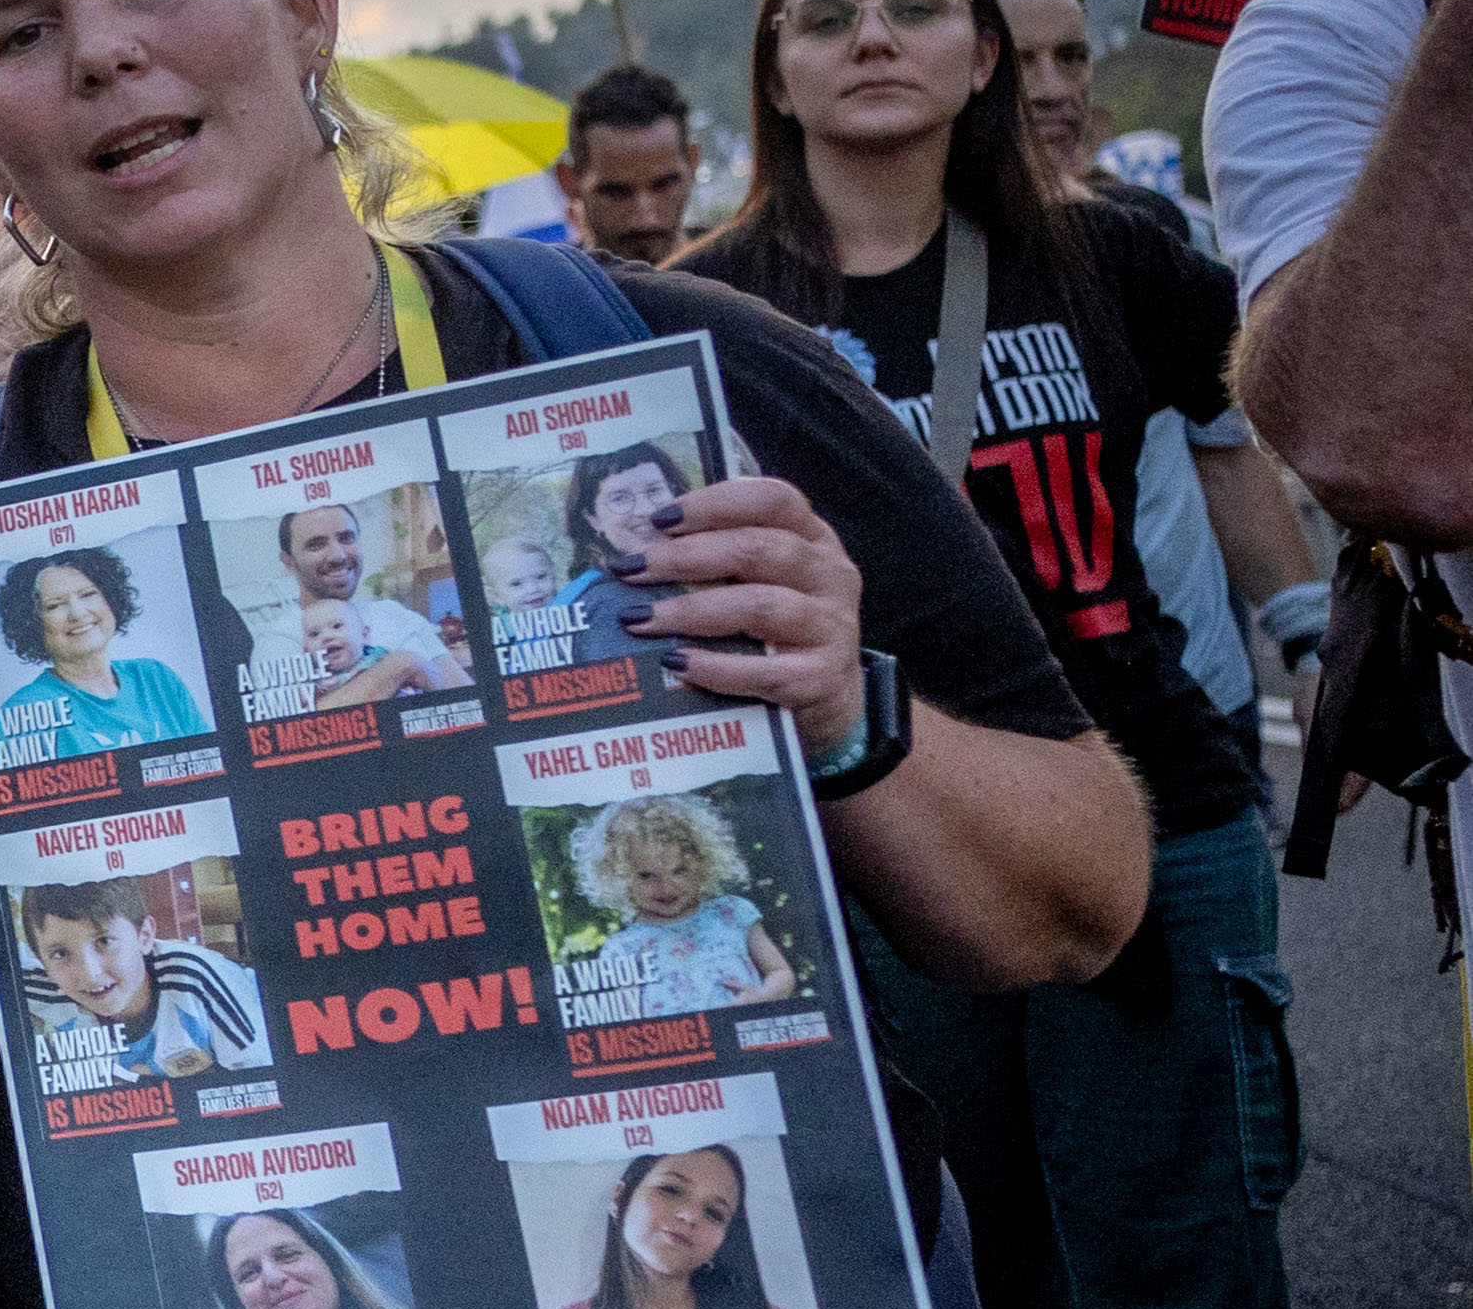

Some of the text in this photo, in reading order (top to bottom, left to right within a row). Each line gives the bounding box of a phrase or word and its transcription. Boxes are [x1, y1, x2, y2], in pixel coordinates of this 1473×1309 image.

[505, 390, 632, 439] ADI SHOHAM
[250, 440, 376, 490] TAL SHOHAM
[71, 480, 142, 518] HARAN
[304, 480, 332, 503] (38)
[48, 523, 76, 547] (67)
[510, 601, 591, 642] WHOLE
[257, 649, 333, 690] WHOLE
[494, 635, 575, 677] FAMILY
[241, 682, 318, 723] FAMILY
[503, 656, 639, 710] IS MISSING!
[247, 702, 379, 757] IS MISSING!
[523, 719, 747, 780] YAHEL GANI SHOHAM
[15, 751, 119, 801] MISSING!
[630, 766, 653, 790] (3)
[34, 808, 187, 858] NAVEH SHOHAM
[279, 794, 470, 860] BRING
[292, 845, 475, 907] THEM
[294, 895, 486, 959] HOME
[572, 951, 659, 991] WHOLE
[286, 966, 540, 1055] NOW!
[558, 988, 644, 1030] FAMILY
[53, 1022, 129, 1060] WHOLE
[566, 1032, 594, 1065] IS
[595, 1012, 713, 1061] MISSING!
[38, 1057, 114, 1095] FAMILY
[45, 1080, 177, 1129] IS MISSING!
[540, 1079, 725, 1131] NOAM AVIGDORI
[623, 1124, 655, 1150] (12)
[173, 1138, 357, 1187] SHARON AVIGDORI
[255, 1180, 285, 1204] (52)
